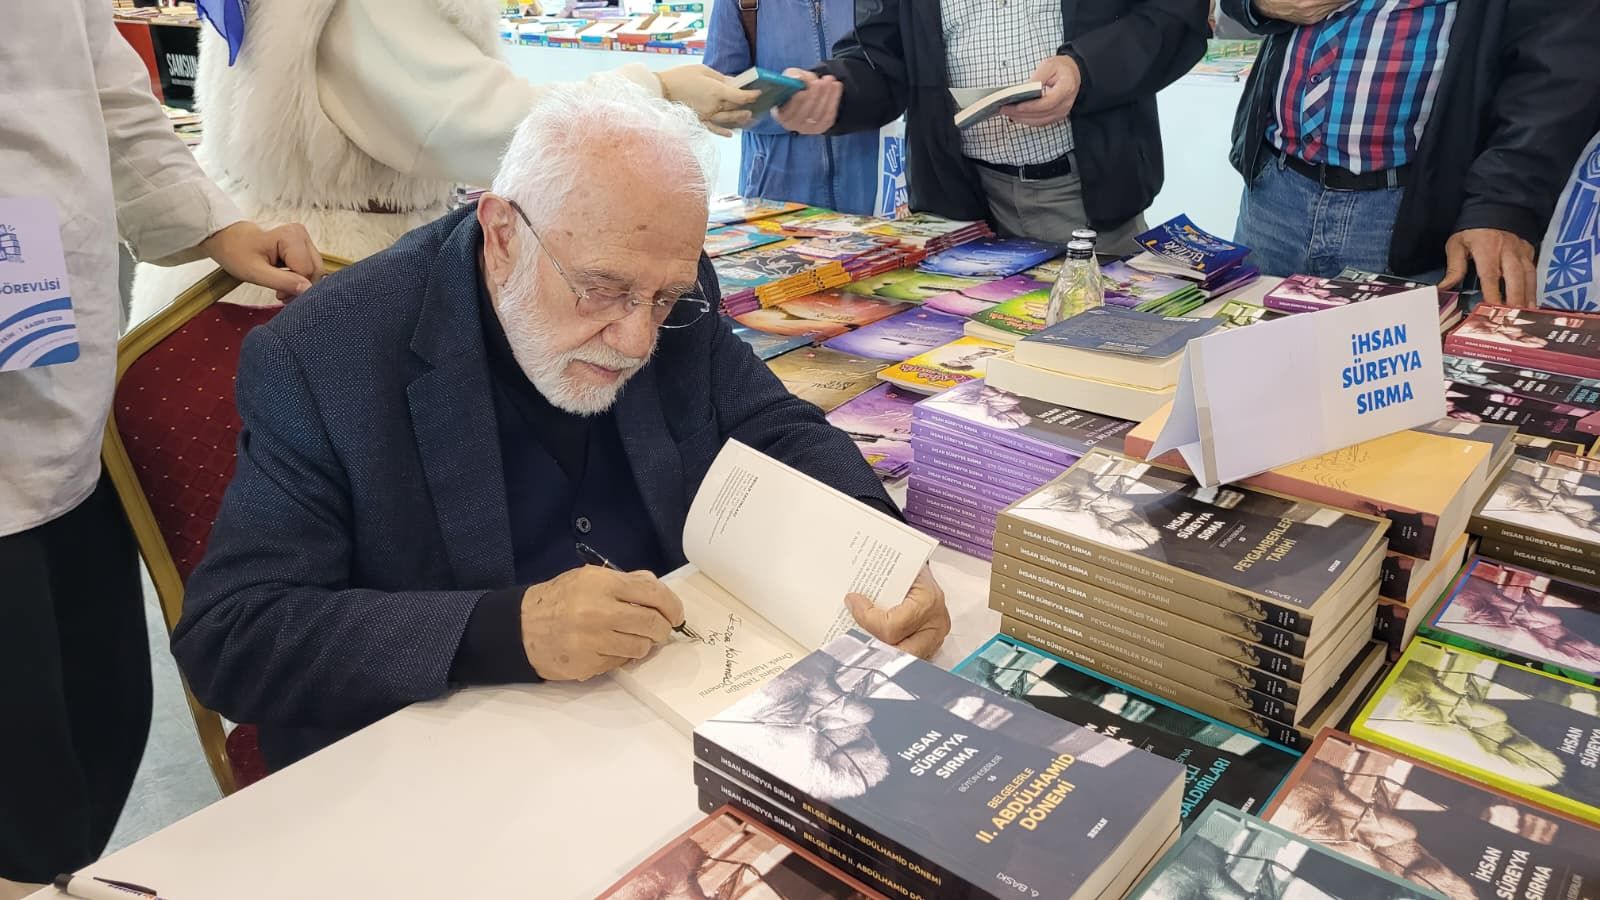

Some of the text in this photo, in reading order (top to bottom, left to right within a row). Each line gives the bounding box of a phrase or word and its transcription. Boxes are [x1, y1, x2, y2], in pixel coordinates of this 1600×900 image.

[0, 277, 60, 294] ÖREVLİSİ
[1352, 324, 1407, 356] İHSAN
[1342, 350, 1422, 388] SÜREYYA
[1356, 382, 1414, 415] SIRMA
[1162, 512, 1194, 530] İHSAN
[1177, 512, 1214, 539] SÜREYYA
[1198, 521, 1226, 540] SIRMA
[1024, 528, 1041, 540] İHSAN
[1043, 536, 1070, 550] SÜREYYA
[1072, 546, 1092, 556] SIRMA
[1233, 518, 1295, 572] PEYGAMBERLER
[1266, 538, 1296, 562] TARİHİ
[1502, 529, 1584, 554] İHSAN SÜREYYA SIRMA
[1020, 547, 1038, 559] İHSAN
[1040, 554, 1067, 569] SÜREYYA
[1068, 564, 1088, 576] SIRMA
[1514, 550, 1596, 575] İHSAN SÜREYYA SIRMA
[1018, 568, 1037, 580] İHSAN
[1038, 576, 1066, 592] SÜREYYA
[1066, 586, 1087, 598] SIRMA
[1016, 588, 1034, 600] İHSAN
[1036, 596, 1063, 611] SÜREYYA
[1064, 606, 1084, 618] SIRMA
[1016, 606, 1034, 618] İHSAN
[1035, 614, 1062, 630] SÜREYYA
[1063, 625, 1083, 638] SIRMA
[1027, 632, 1046, 645] İHSAN
[1046, 640, 1074, 656] SÜREYYA
[1076, 652, 1096, 664] SIRMA
[897, 730, 942, 760] İHSAN
[910, 734, 968, 776] SÜREYYA
[1557, 726, 1583, 755] İHSAN
[936, 747, 979, 780] SIRMA
[976, 754, 1075, 844] II. ABDÜLHAMİD
[987, 768, 1035, 808] BELGELERLE
[1019, 778, 1076, 830] DÖNEMİ
[1181, 758, 1232, 818] SALDIRILARI
[720, 756, 740, 772] İHSAN
[742, 768, 772, 790] SÜREYYA
[774, 786, 796, 804] SIRMA
[802, 802, 846, 832] BELGELERLE
[856, 833, 907, 866] ABDÜLHAMİD
[908, 863, 942, 887] DÖNEMİ
[720, 784, 741, 802] İHSAN
[742, 798, 772, 820] SÜREYYA
[774, 815, 796, 832] SIRMA
[804, 832, 847, 862] BELGELERLE
[856, 863, 908, 896] ABDÜLHAMİD
[1470, 846, 1503, 882] İHSAN
[1496, 849, 1531, 900] SÜREYYA
[996, 872, 1028, 894] BASKI
[1525, 866, 1553, 900] SIRMA
